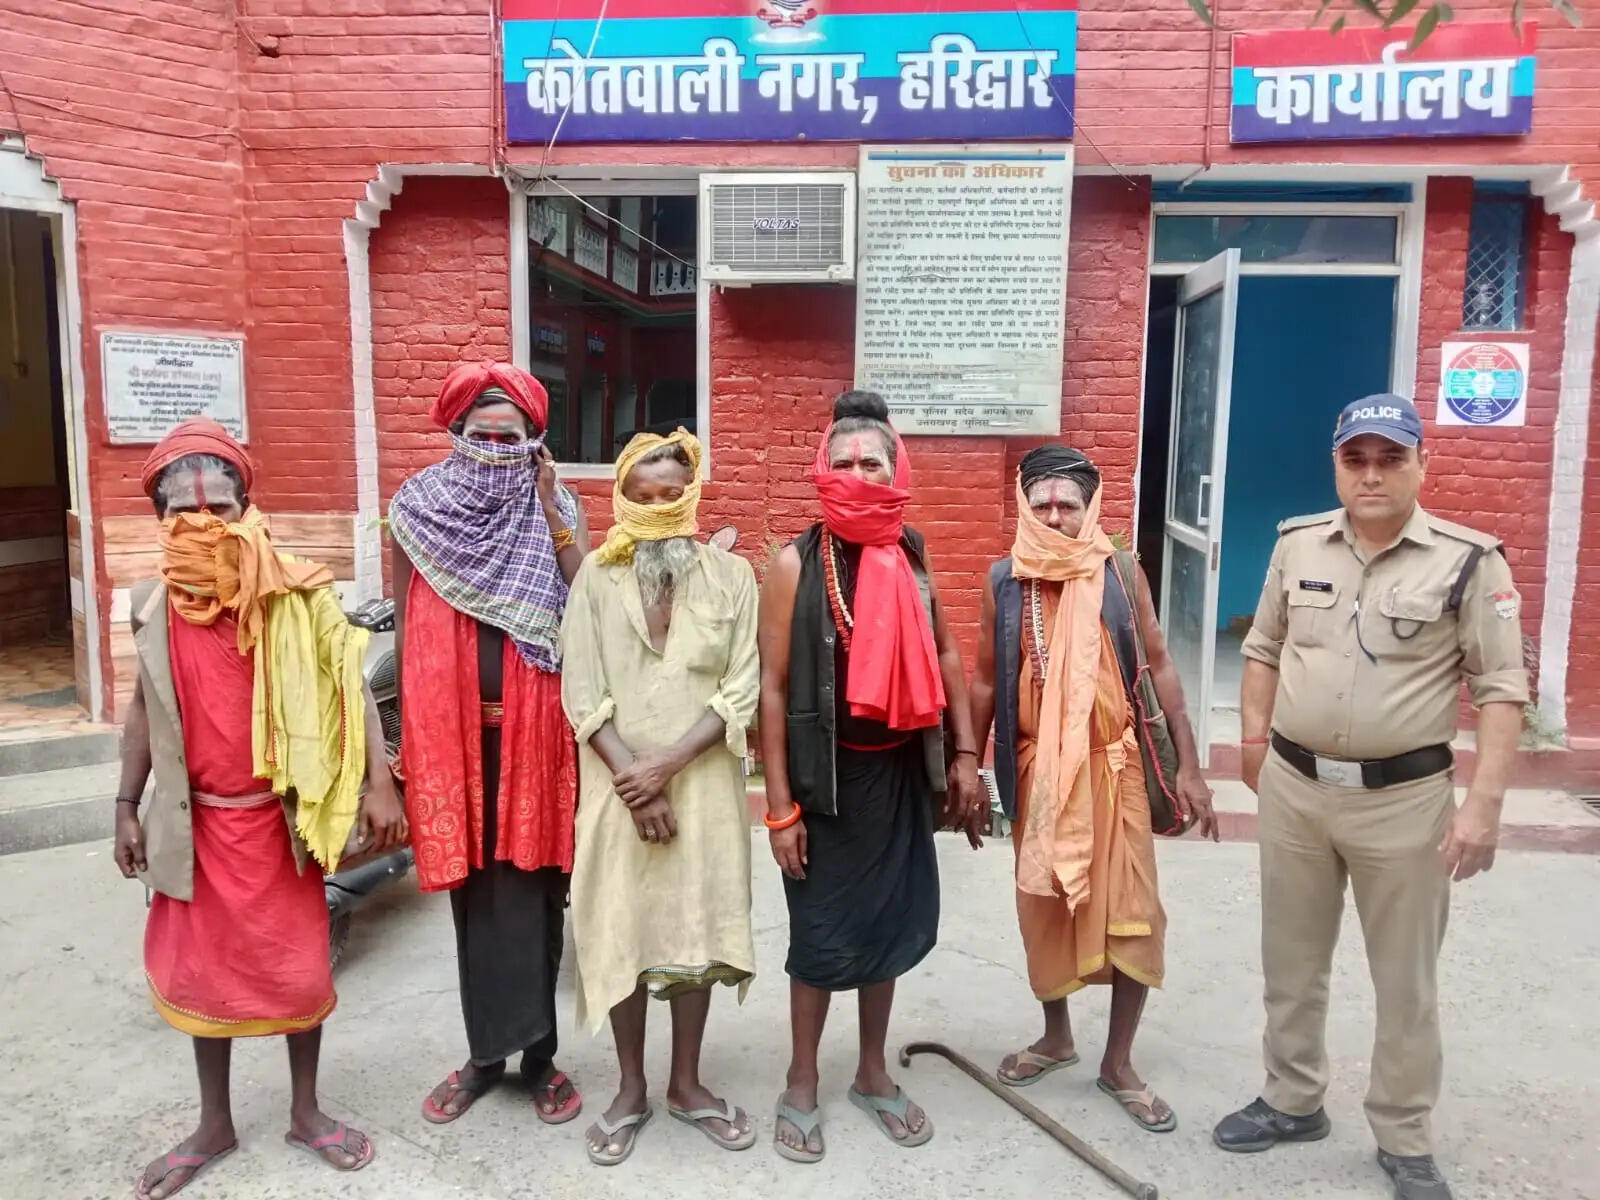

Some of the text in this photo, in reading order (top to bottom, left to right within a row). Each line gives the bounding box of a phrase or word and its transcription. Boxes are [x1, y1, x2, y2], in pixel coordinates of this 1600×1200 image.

[523, 33, 1059, 124] कोतवाली नगर, हरिद्वार
[1253, 42, 1518, 124] कार्यालय
[752, 217, 799, 229] VOLTAS
[1351, 406, 1402, 422] POLICE
